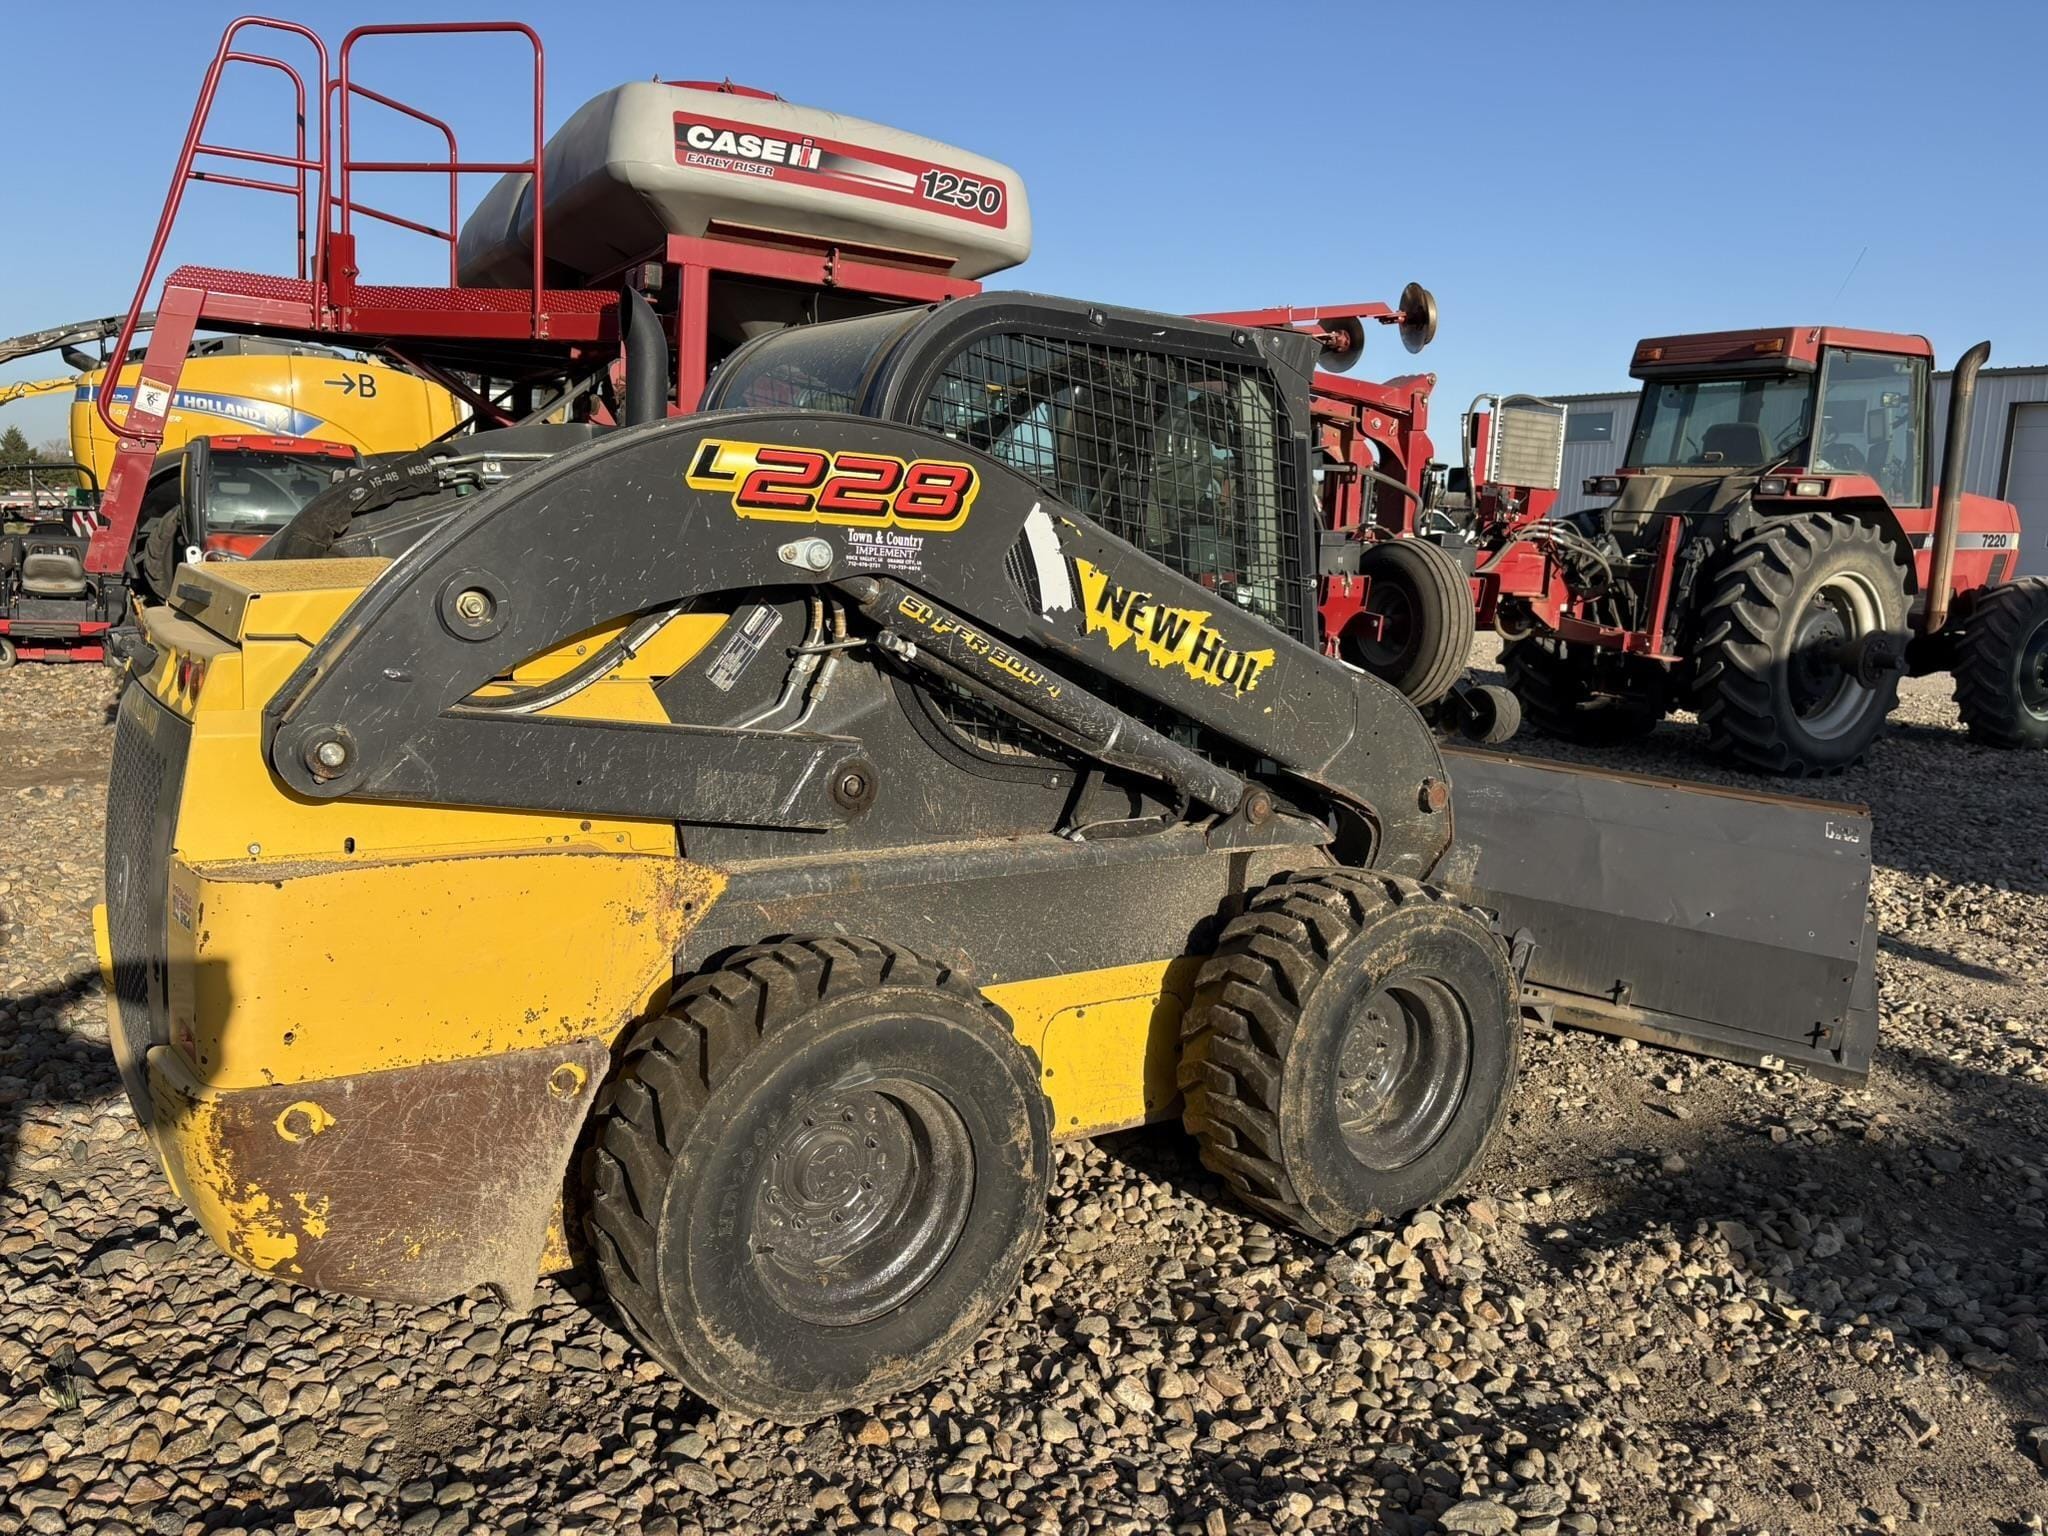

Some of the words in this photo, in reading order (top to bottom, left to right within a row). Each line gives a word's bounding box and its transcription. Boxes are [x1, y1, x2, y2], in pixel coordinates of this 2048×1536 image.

[687, 125, 787, 163] CASE
[686, 153, 732, 168] EARLY
[732, 161, 775, 177] RISER
[921, 169, 1002, 215] 1250
[359, 374, 377, 398] B
[183, 394, 261, 421] HOLLAND
[847, 527, 873, 543] Town
[875, 530, 884, 545] &
[886, 531, 924, 551] Country
[1982, 534, 2007, 548] 7220
[855, 545, 914, 558] IMPLEMENT
[1095, 576, 1191, 653] NEW
